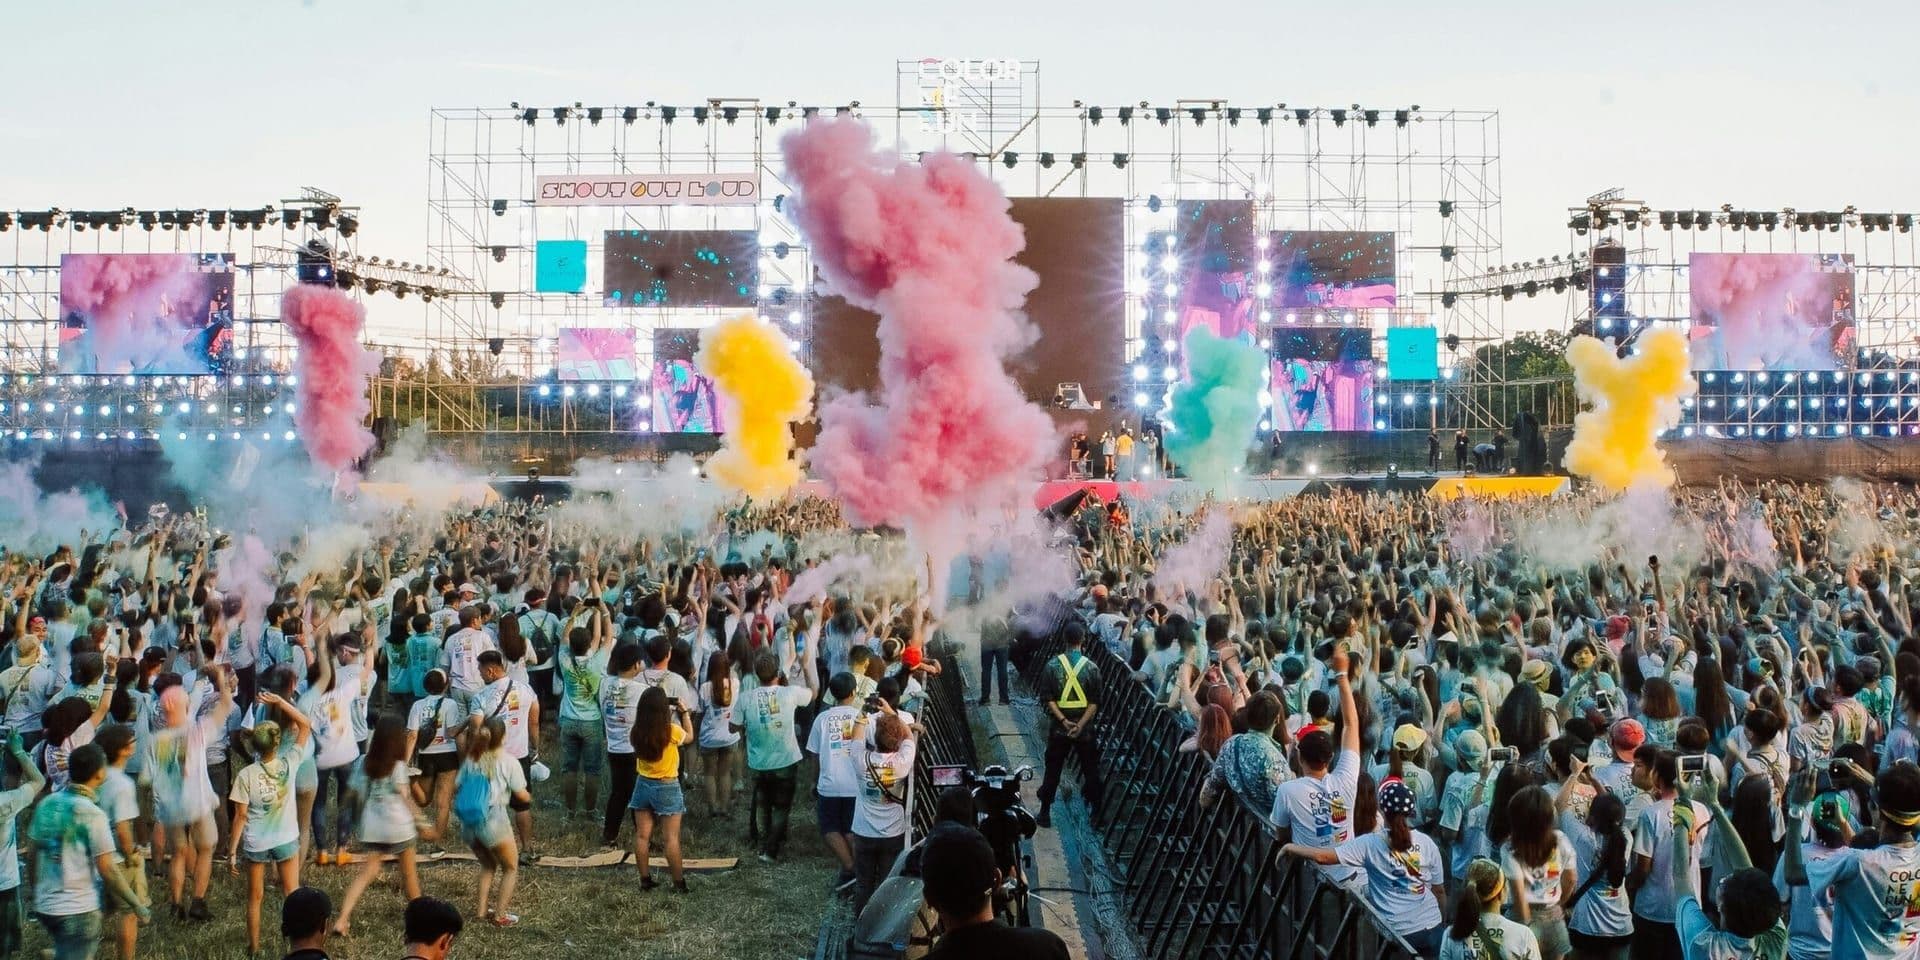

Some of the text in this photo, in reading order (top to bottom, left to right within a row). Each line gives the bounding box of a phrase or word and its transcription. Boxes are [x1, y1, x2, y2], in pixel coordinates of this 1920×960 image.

[918, 57, 1022, 80] COLOR
[542, 180, 755, 199] SHOUT OUT LOUD
[1309, 790, 1341, 801] COLOR
[1885, 894, 1912, 906] RUN
